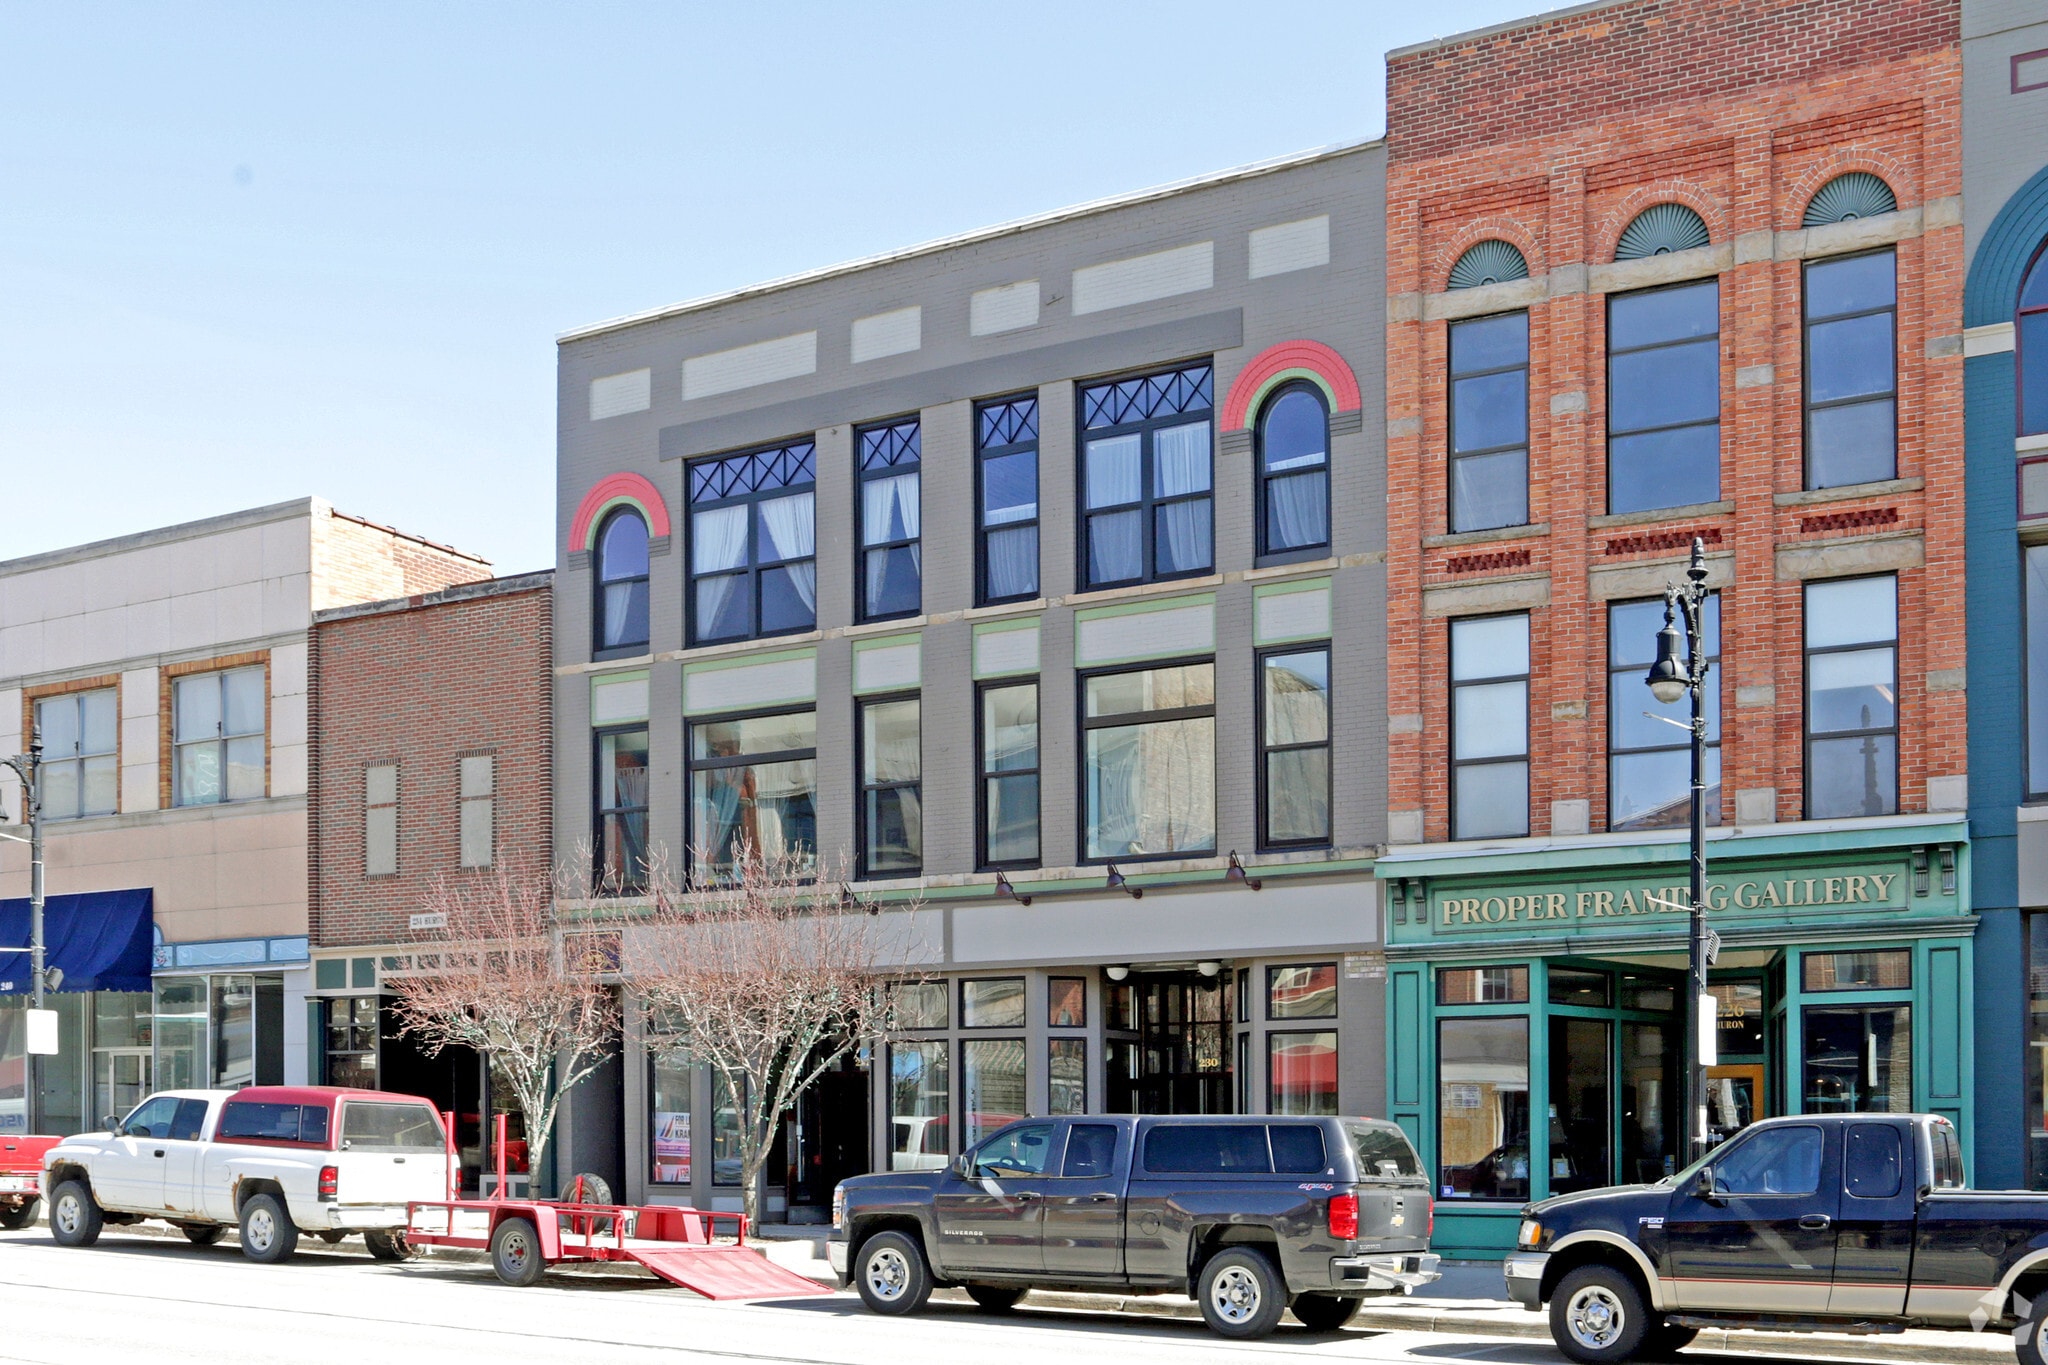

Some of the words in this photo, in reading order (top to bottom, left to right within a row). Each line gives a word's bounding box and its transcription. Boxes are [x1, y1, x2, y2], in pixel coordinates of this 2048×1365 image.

[1442, 893, 1568, 924] PROPER
[1733, 873, 1897, 909] GALLERY
[1199, 1058, 1218, 1067] 230
